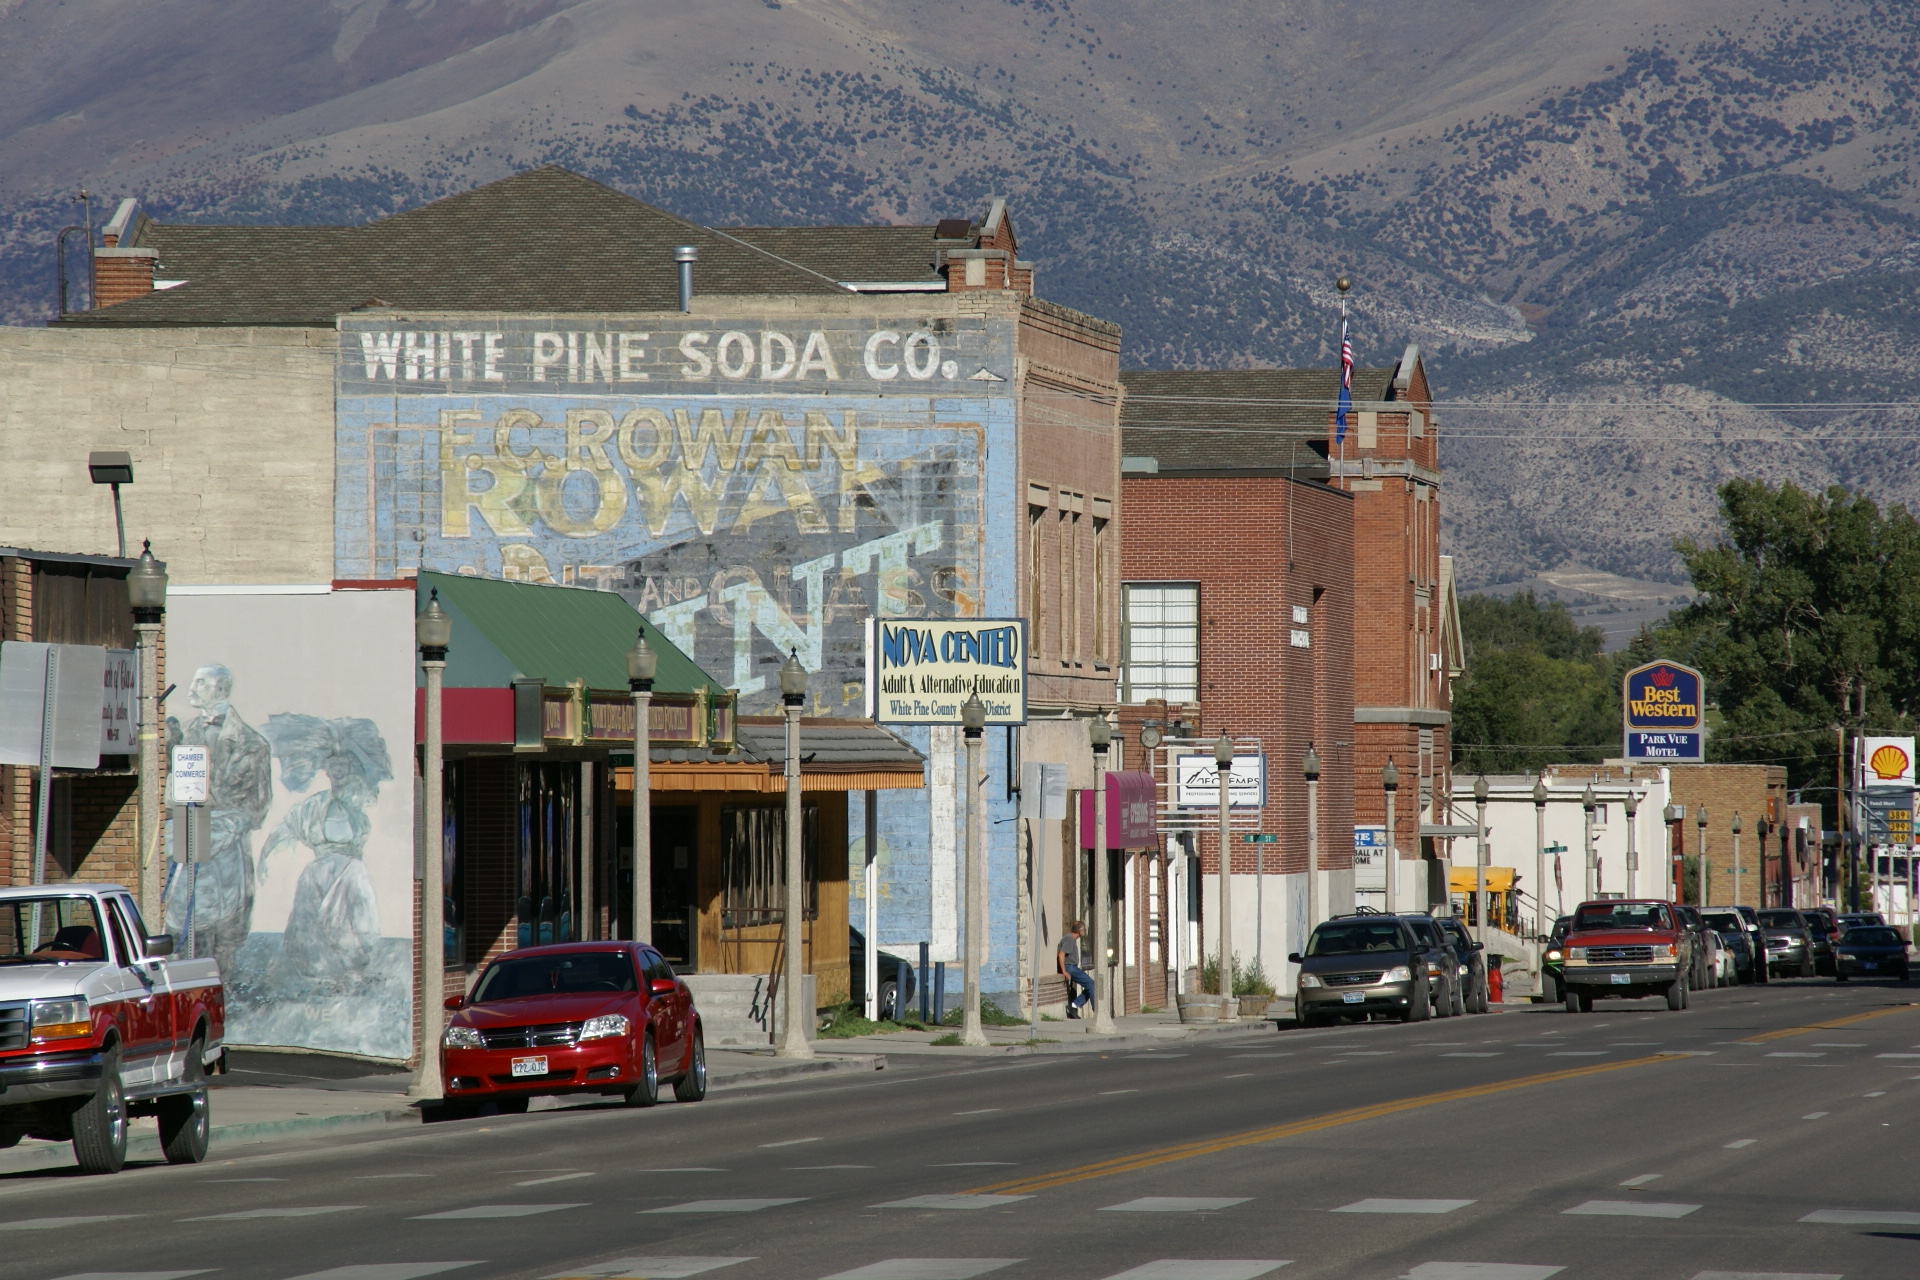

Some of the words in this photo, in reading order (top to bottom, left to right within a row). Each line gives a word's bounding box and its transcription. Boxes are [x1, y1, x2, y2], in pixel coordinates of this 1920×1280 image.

[360, 331, 504, 381] WHITE
[532, 331, 650, 383] PINE
[679, 330, 840, 381] SODA
[863, 330, 959, 381] CO.
[566, 407, 857, 471] ROWAN
[882, 623, 938, 671] NOVA
[940, 625, 1018, 671] CENTER
[881, 674, 907, 694] Adult
[909, 674, 916, 694] &
[920, 674, 972, 694] Alternative
[974, 674, 1020, 694] Education
[1643, 685, 1681, 703] Best
[890, 700, 912, 716] White
[914, 700, 930, 716] Pine
[931, 700, 957, 719] County
[985, 700, 1011, 716] District
[1630, 700, 1697, 717] Western
[177, 753, 204, 762] CHAMBER
[187, 762, 195, 770] OF
[175, 770, 206, 778] COMMERCE
